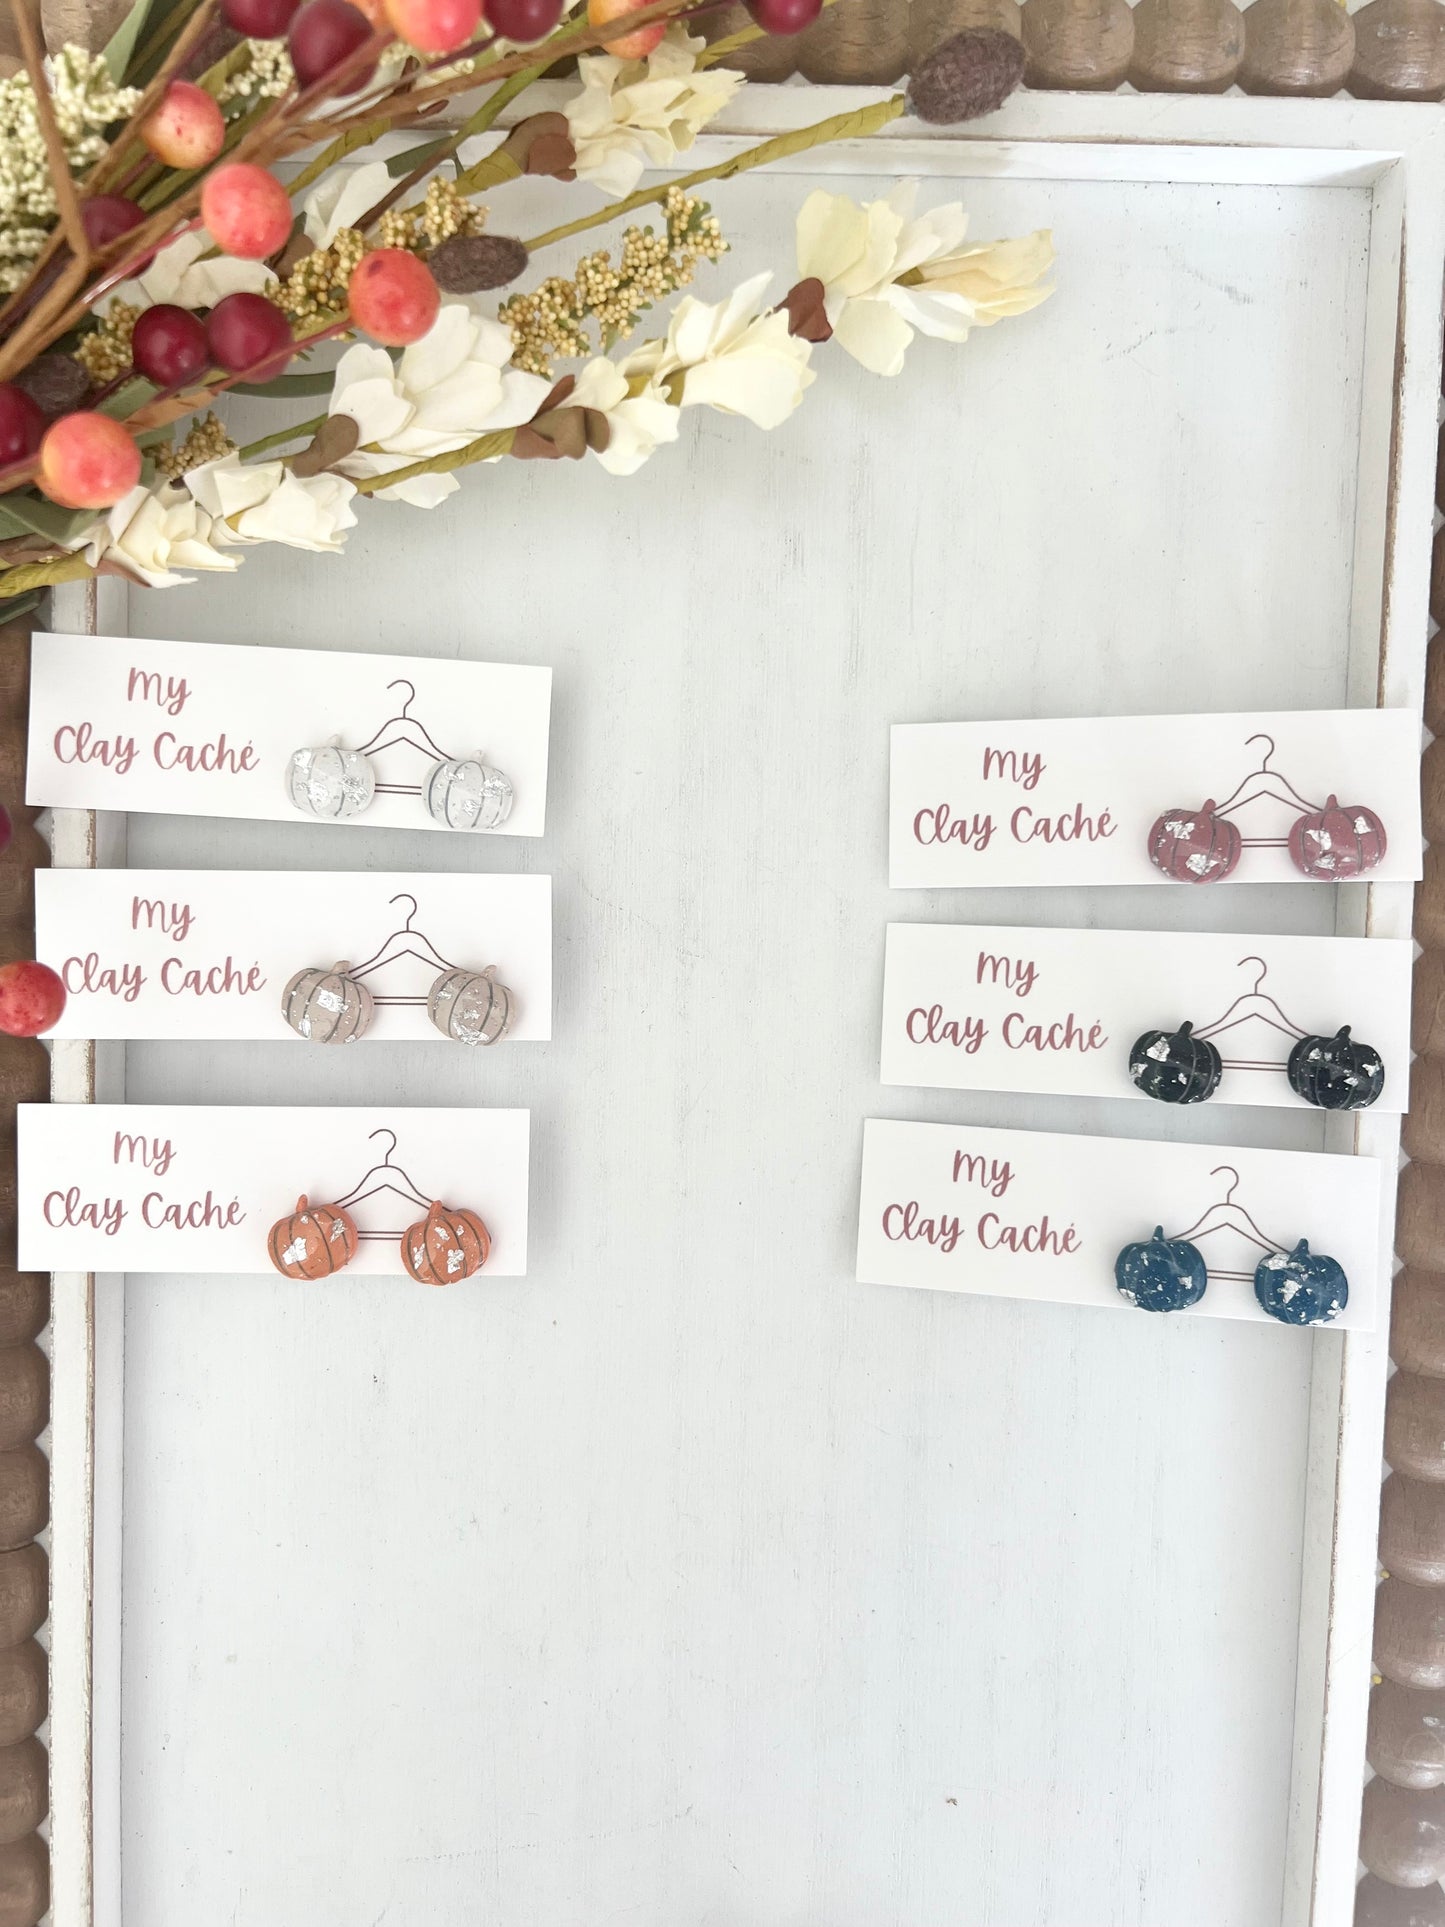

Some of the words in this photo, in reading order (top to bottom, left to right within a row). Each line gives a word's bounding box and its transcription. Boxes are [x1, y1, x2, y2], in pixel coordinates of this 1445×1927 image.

[127, 667, 193, 716] My
[53, 722, 140, 774] Clay
[153, 731, 260, 773] Caché
[983, 747, 1047, 791] My
[913, 803, 997, 850] Clay
[1010, 804, 1118, 844] Caché
[131, 896, 196, 942] My
[61, 953, 147, 1002] Clay
[160, 957, 267, 997] Caché
[976, 951, 1040, 997] My
[906, 1005, 989, 1054] Clay
[1002, 1013, 1108, 1052] Caché
[113, 1131, 177, 1176] My
[952, 1150, 1016, 1197] My
[43, 1187, 128, 1236] Clay
[141, 1191, 247, 1231] Caché
[881, 1201, 965, 1252] Clay
[977, 1212, 1082, 1255] Caché
